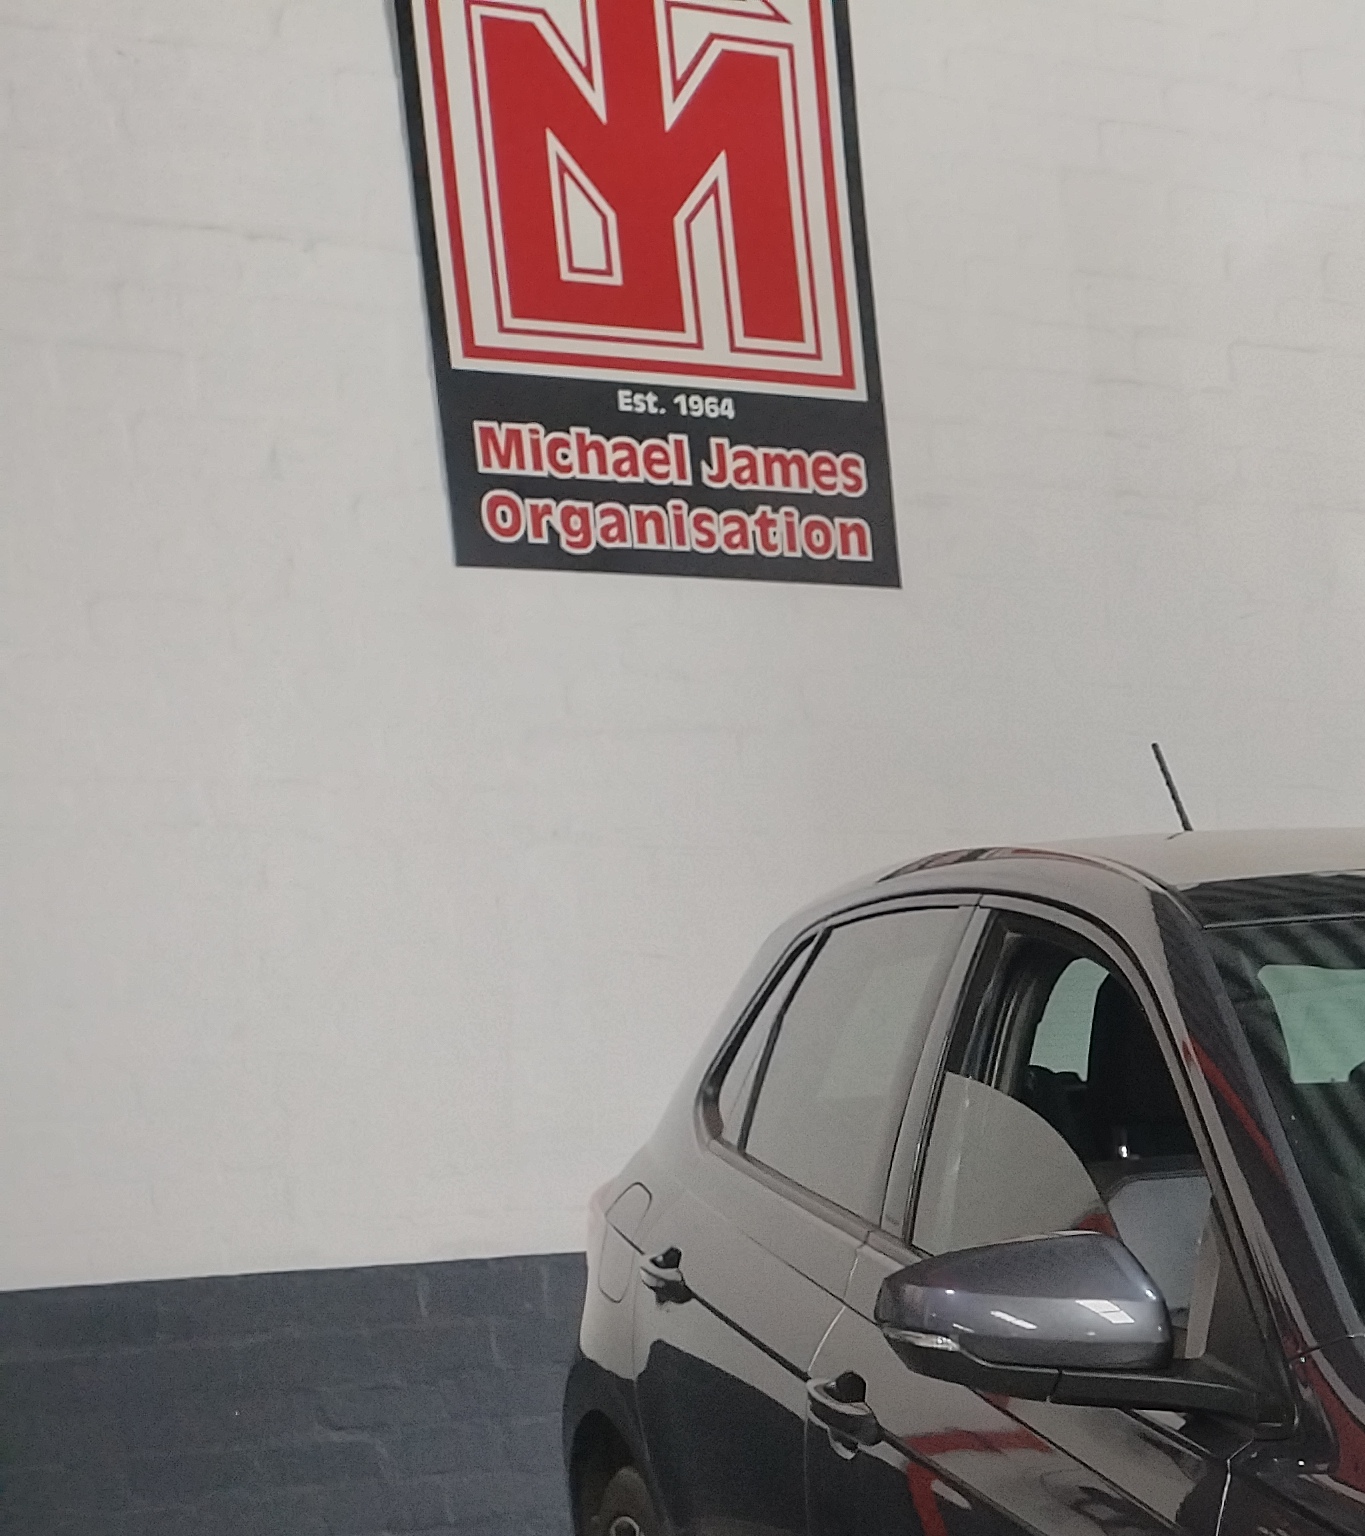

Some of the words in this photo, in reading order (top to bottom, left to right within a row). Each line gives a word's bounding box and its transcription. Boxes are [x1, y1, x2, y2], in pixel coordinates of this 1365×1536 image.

[617, 389, 666, 415] Est.
[674, 393, 736, 420] 1964
[473, 420, 692, 486] Michael
[702, 436, 868, 498] James
[481, 488, 873, 562] Organisation
